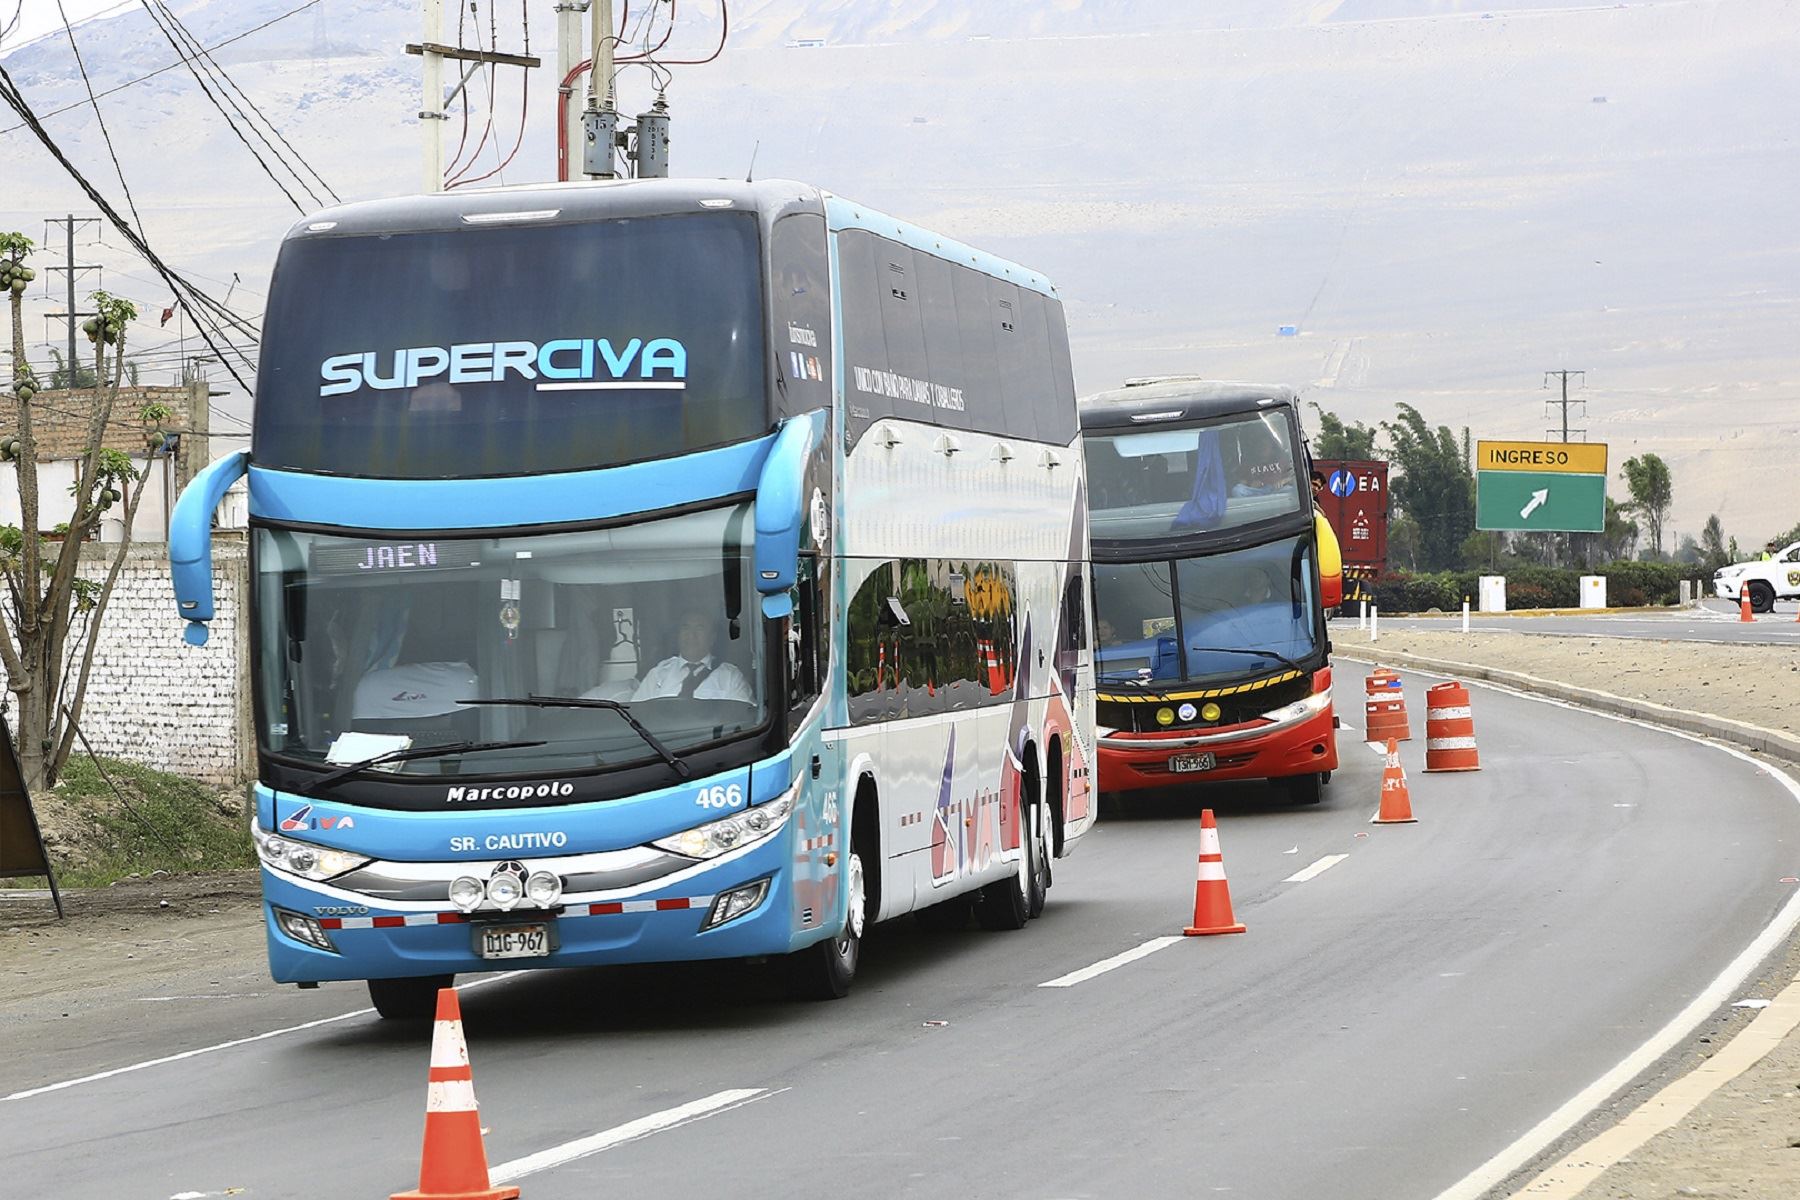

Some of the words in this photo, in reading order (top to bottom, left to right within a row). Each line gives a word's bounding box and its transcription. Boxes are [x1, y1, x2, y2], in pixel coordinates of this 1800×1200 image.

[595, 119, 606, 129] 15
[319, 337, 687, 397] SUPERCIVA
[1489, 449, 1569, 465] INGRESO
[358, 543, 438, 569] JAEN
[446, 781, 574, 802] Marcopolo
[695, 783, 742, 809] 466
[450, 836, 480, 852] SR.
[485, 831, 568, 850] CAUTIVO
[313, 905, 369, 915] VOLVO
